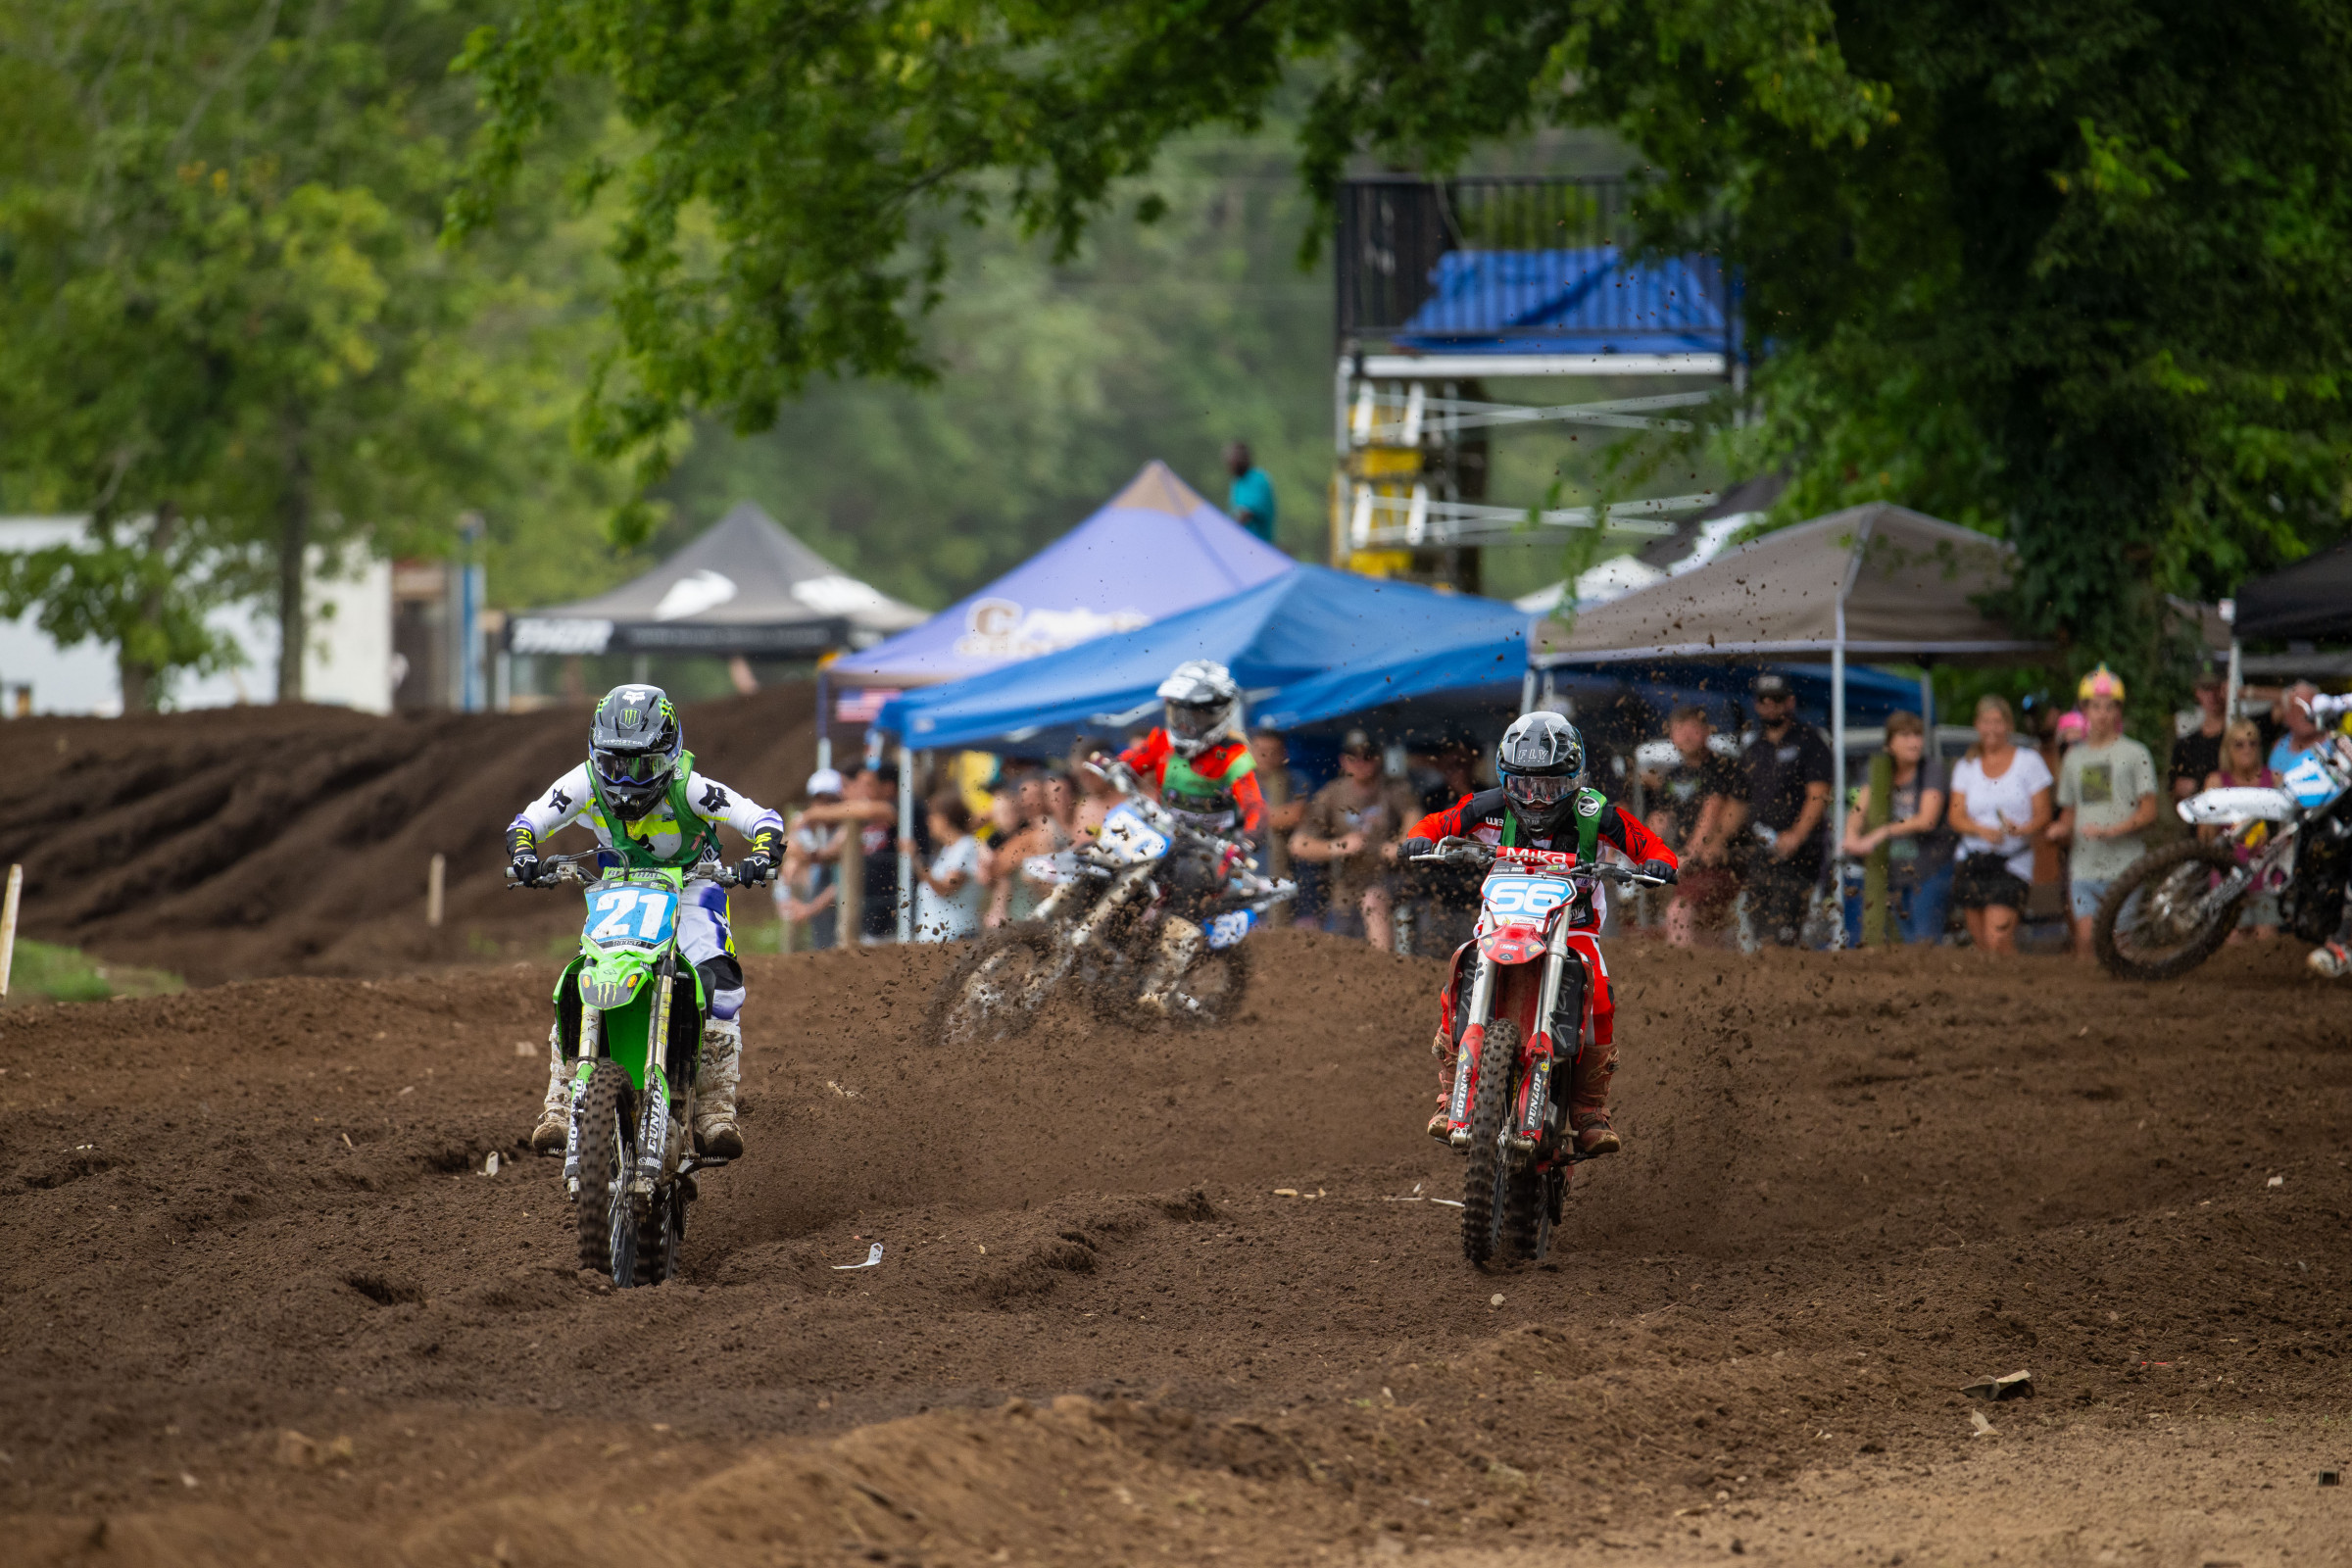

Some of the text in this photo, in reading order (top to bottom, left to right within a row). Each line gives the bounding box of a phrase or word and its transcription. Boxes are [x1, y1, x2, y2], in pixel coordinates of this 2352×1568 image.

[1518, 749, 1548, 760] FLY
[608, 869, 660, 878] RETHAL
[1489, 881, 1565, 914] 66
[591, 889, 668, 940] 21
[1528, 1073, 1543, 1128] DUNLOP
